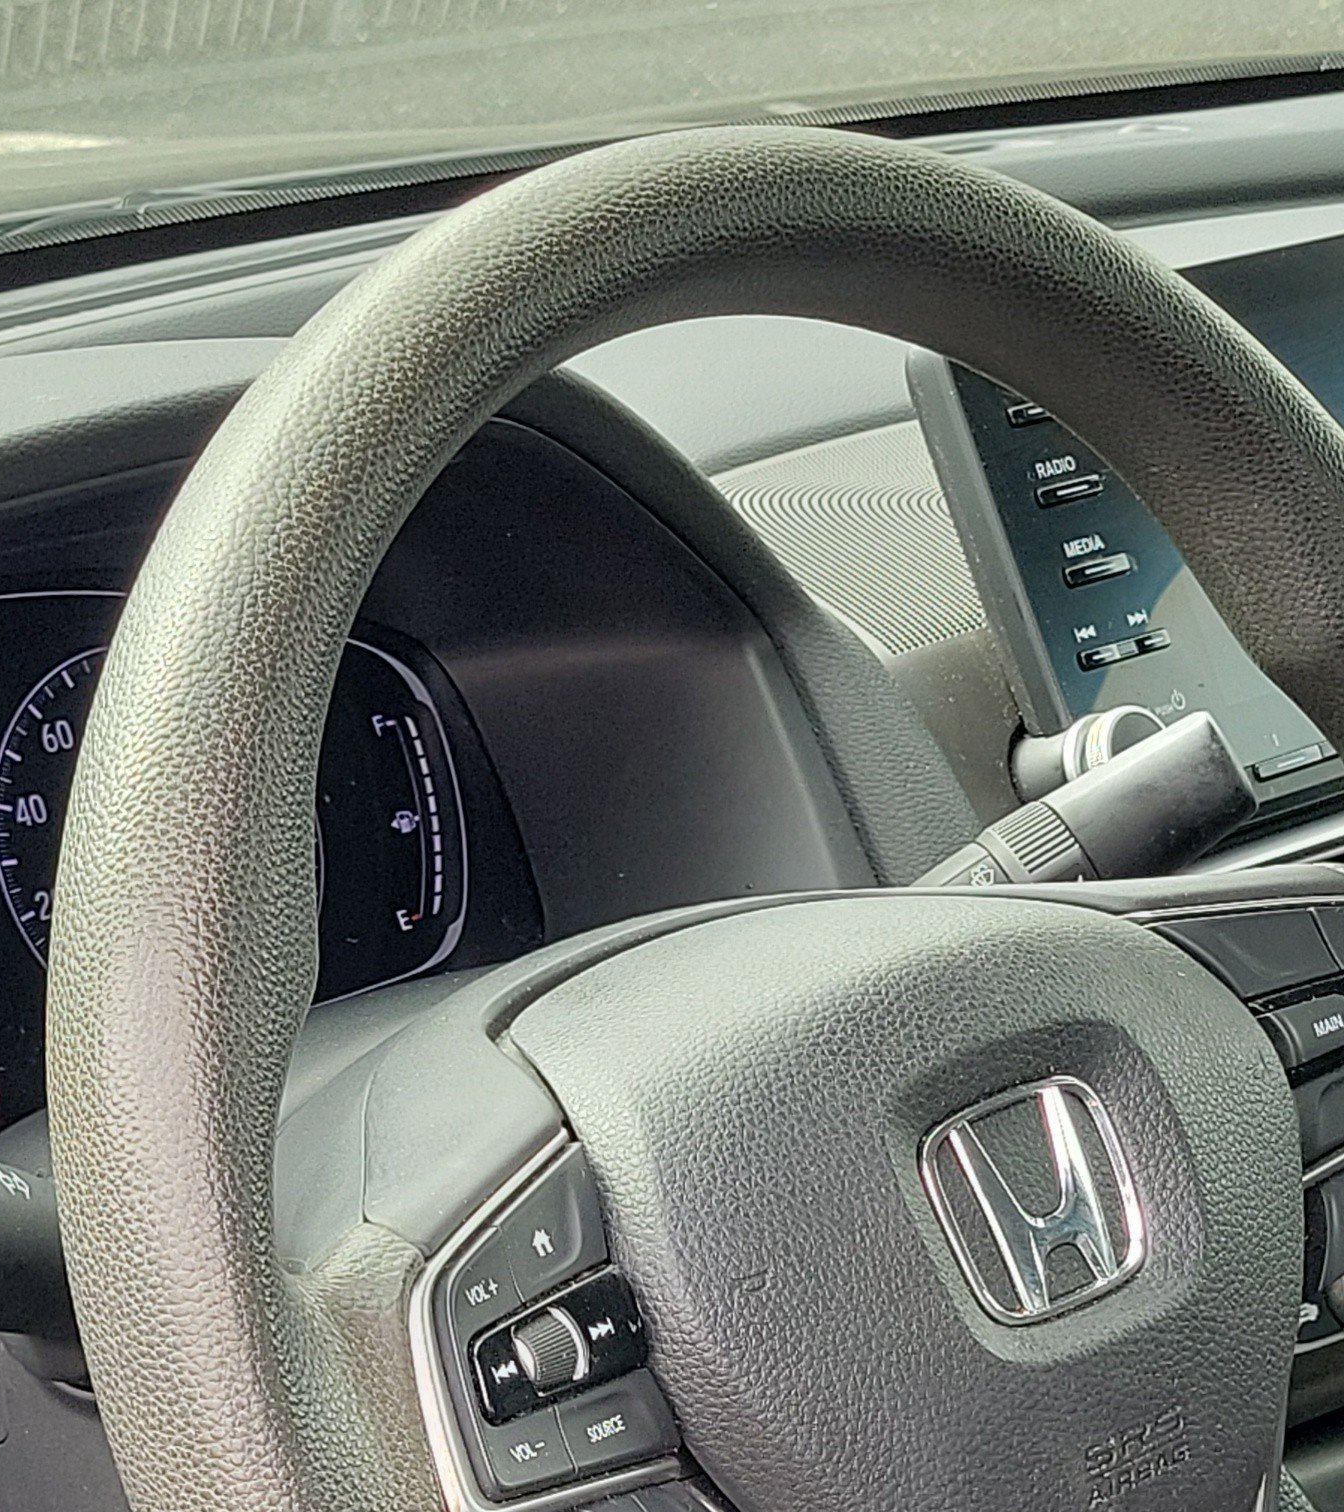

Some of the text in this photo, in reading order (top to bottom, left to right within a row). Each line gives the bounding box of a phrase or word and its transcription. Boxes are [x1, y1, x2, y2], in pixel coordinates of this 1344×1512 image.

[1035, 455, 1076, 479] RADIO
[1063, 534, 1106, 558] MEDIA
[41, 719, 74, 752] 60
[371, 714, 383, 737] F
[16, 794, 48, 826] 40
[396, 909, 413, 931] E
[1313, 1013, 1344, 1038] MAIN
[586, 1414, 626, 1444] SOURCE
